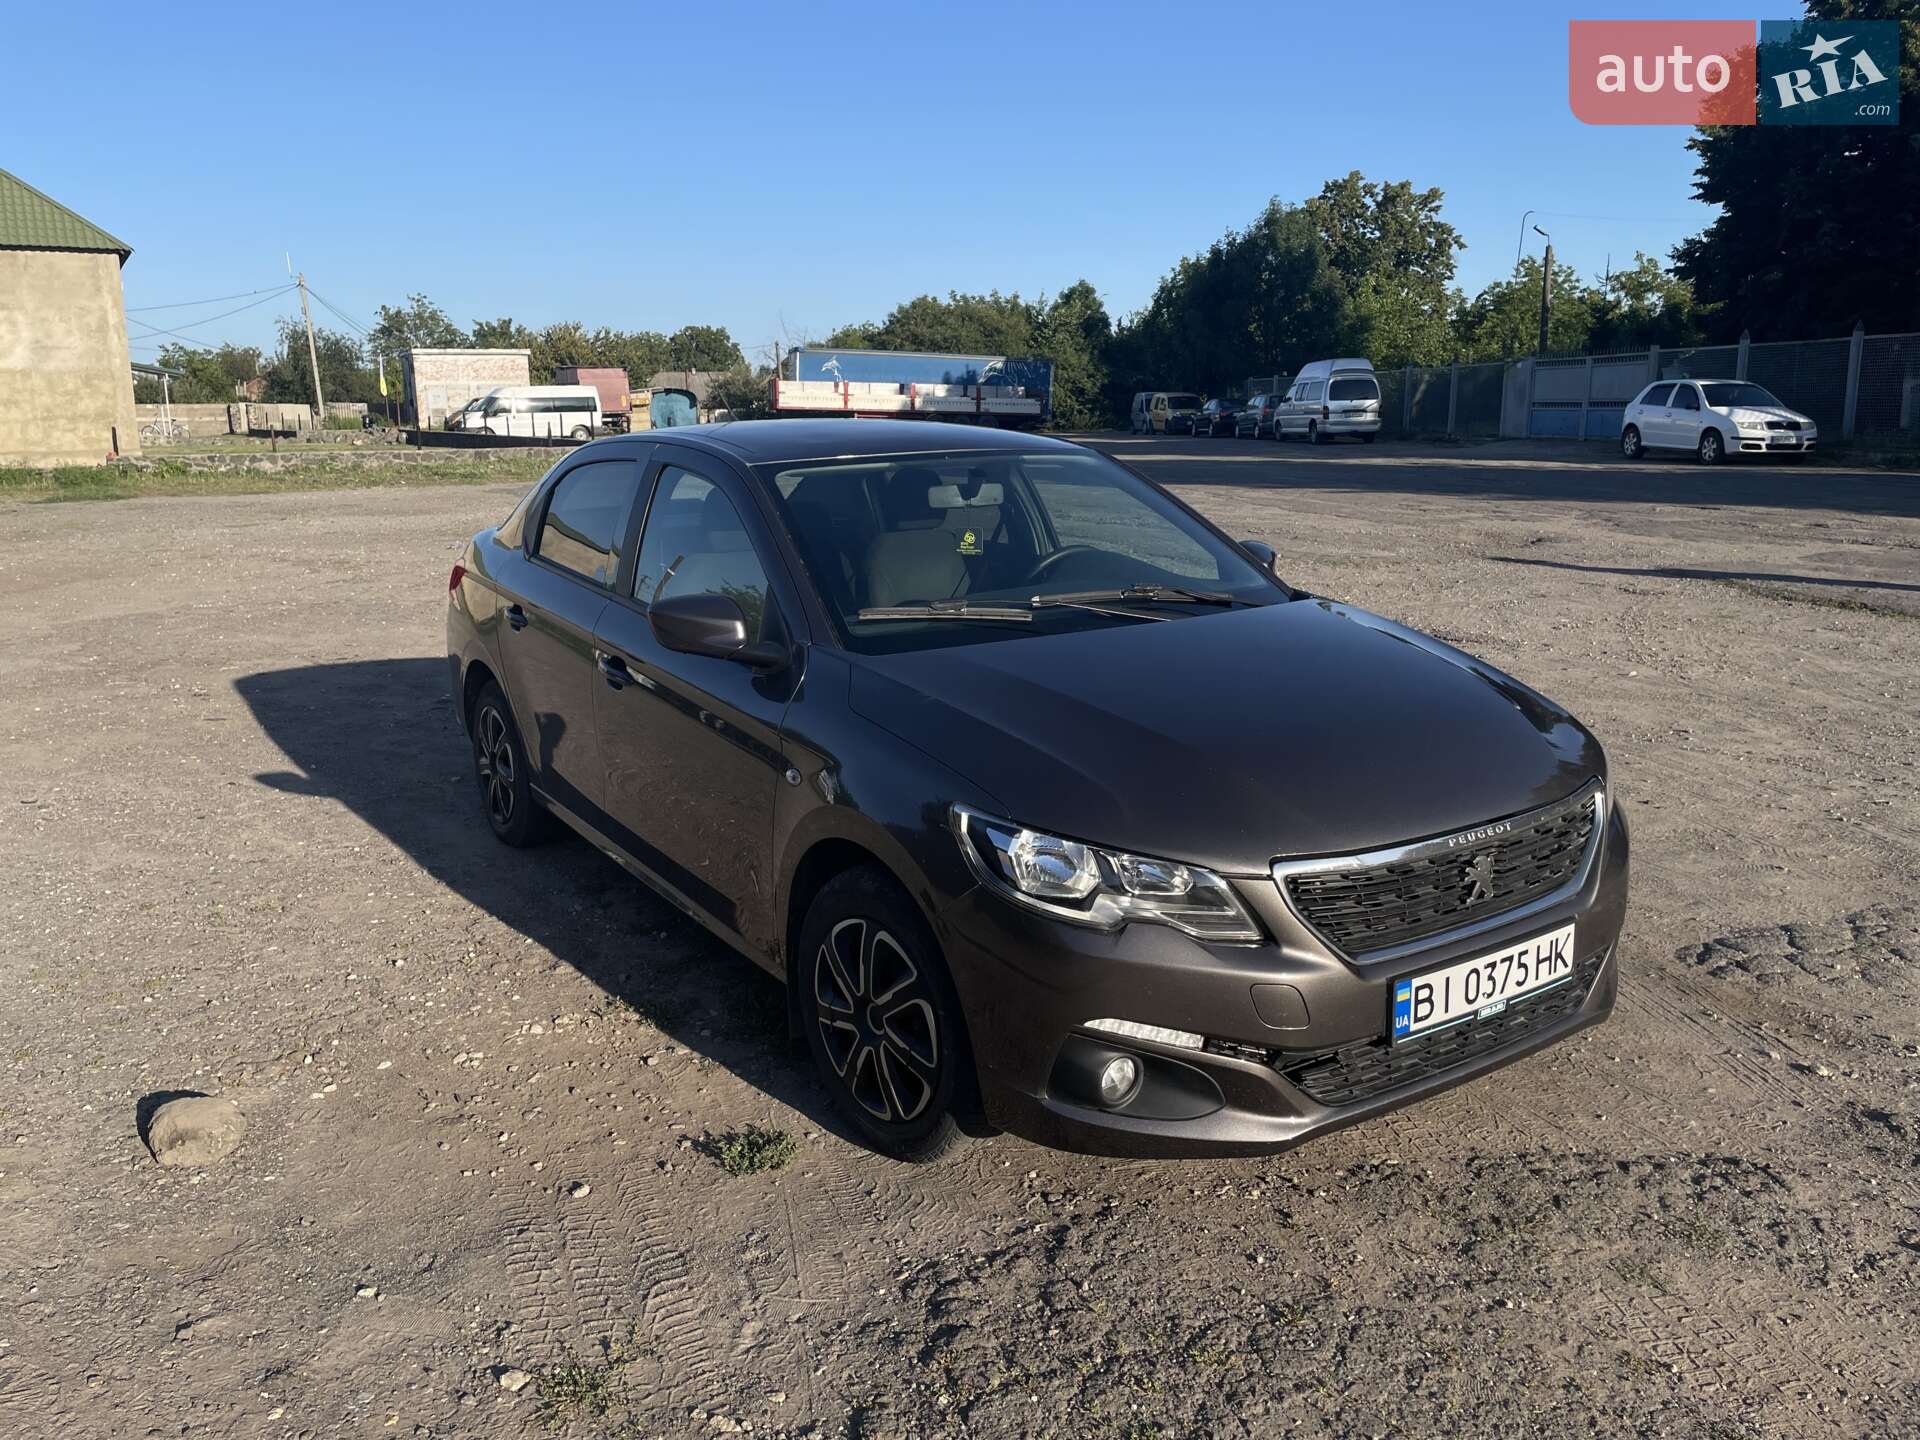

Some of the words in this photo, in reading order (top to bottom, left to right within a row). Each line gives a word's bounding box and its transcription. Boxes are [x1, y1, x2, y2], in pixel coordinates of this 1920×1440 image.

[1448, 822, 1512, 847] PEUGEOT
[1413, 976, 1451, 1024] BI
[1464, 949, 1529, 1005] 0375
[1535, 932, 1571, 981] HK
[1396, 1014, 1410, 1029] UA
